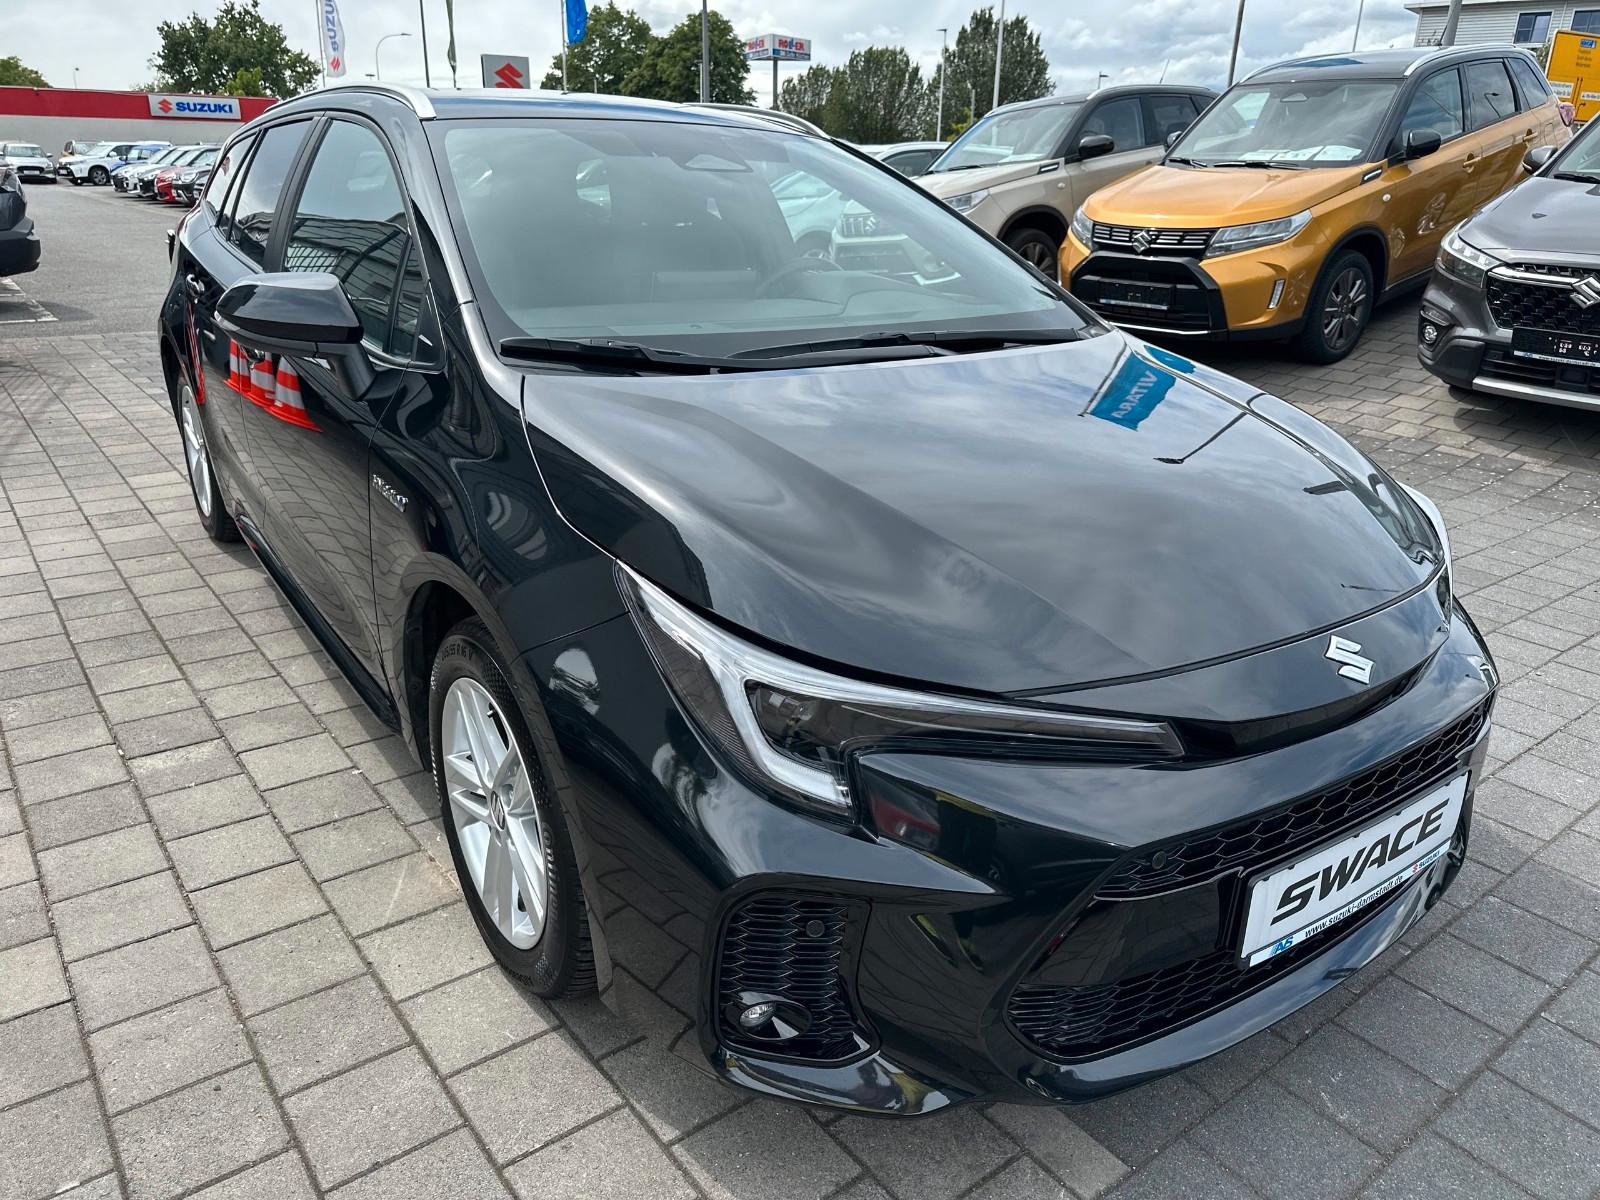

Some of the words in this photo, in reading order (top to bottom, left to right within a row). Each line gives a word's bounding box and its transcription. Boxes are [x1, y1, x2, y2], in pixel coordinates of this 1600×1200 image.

[175, 101, 233, 113] SUZUKI
[1270, 798, 1449, 926] SWACE
[1305, 875, 1403, 938] www.suzuki-darmstadt.de
